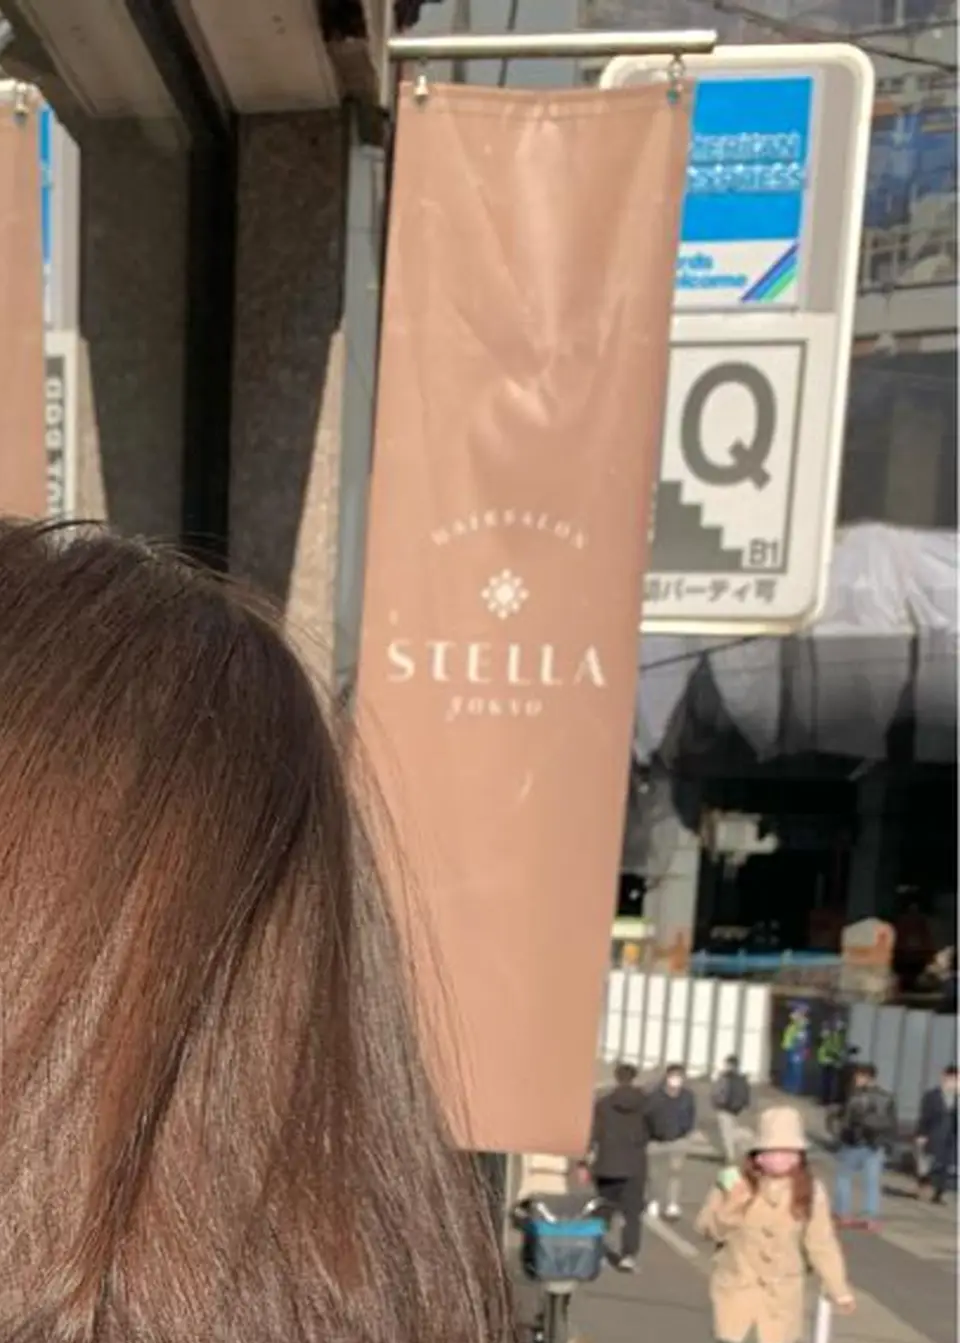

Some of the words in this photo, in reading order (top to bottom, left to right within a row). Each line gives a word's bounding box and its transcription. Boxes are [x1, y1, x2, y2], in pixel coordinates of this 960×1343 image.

[681, 361, 777, 490] Q
[749, 538, 778, 565] B1
[387, 639, 607, 688] STELLA
[444, 696, 543, 721] TOKYO
